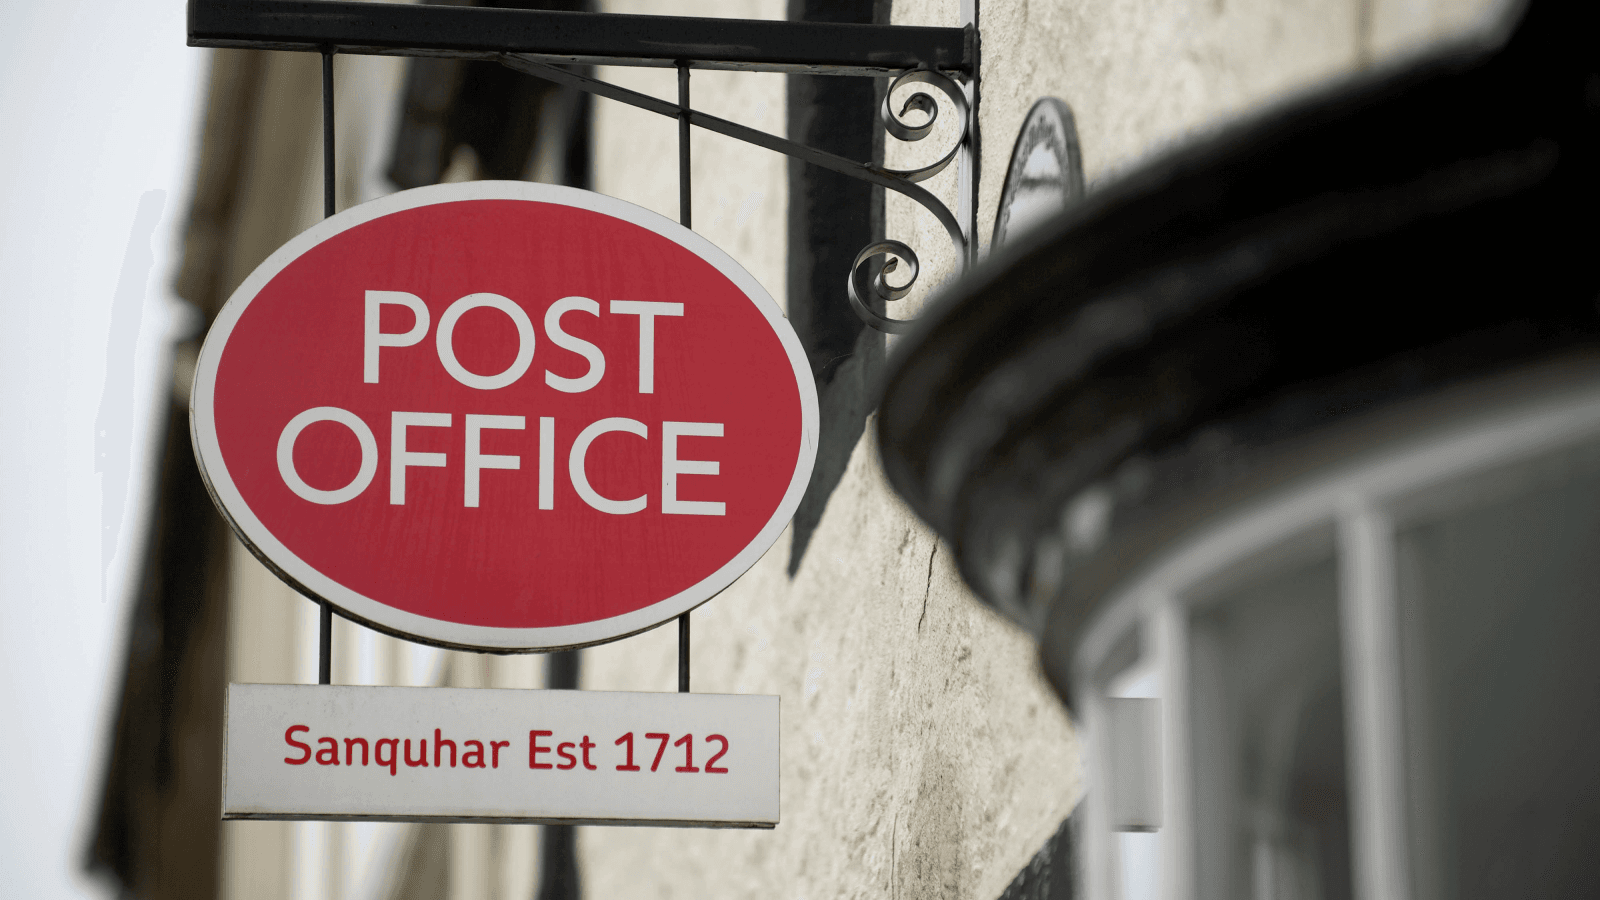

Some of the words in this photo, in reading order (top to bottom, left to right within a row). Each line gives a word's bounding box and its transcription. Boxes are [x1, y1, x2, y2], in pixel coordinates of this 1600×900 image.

[363, 289, 684, 394] POST
[276, 406, 727, 516] OFFICE
[283, 724, 510, 777] Sanquhar
[528, 729, 598, 771] Est
[614, 731, 729, 774] 1712
